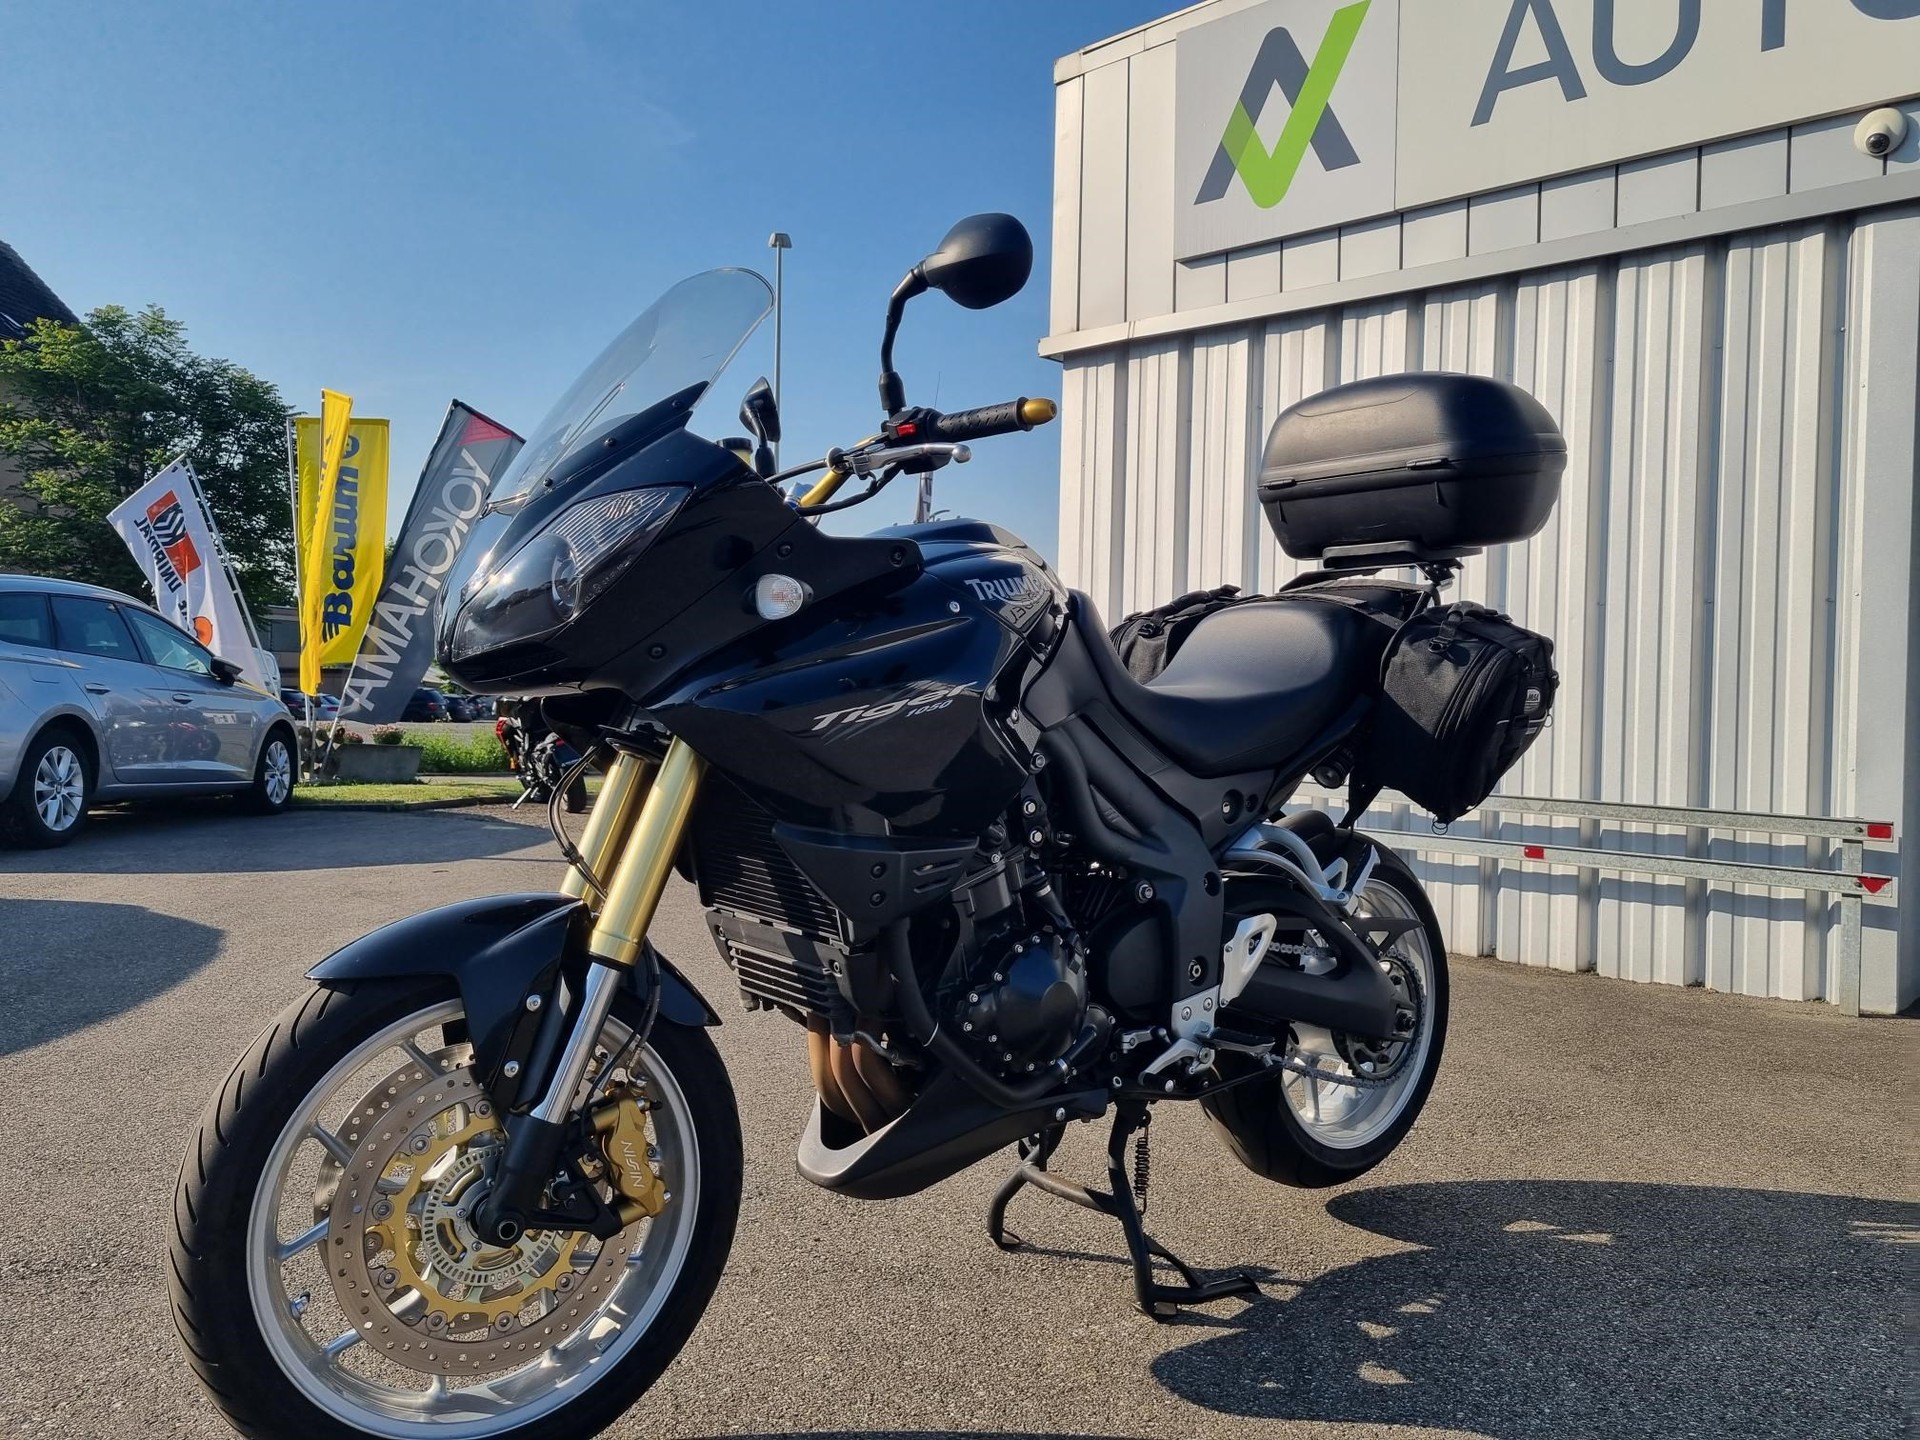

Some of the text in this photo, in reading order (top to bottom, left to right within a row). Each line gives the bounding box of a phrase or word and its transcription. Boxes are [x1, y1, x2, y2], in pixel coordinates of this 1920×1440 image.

[1470, 0, 1920, 127] AU
[322, 467, 360, 643] Barum
[811, 681, 978, 731] Tiger
[905, 699, 953, 718] 1050
